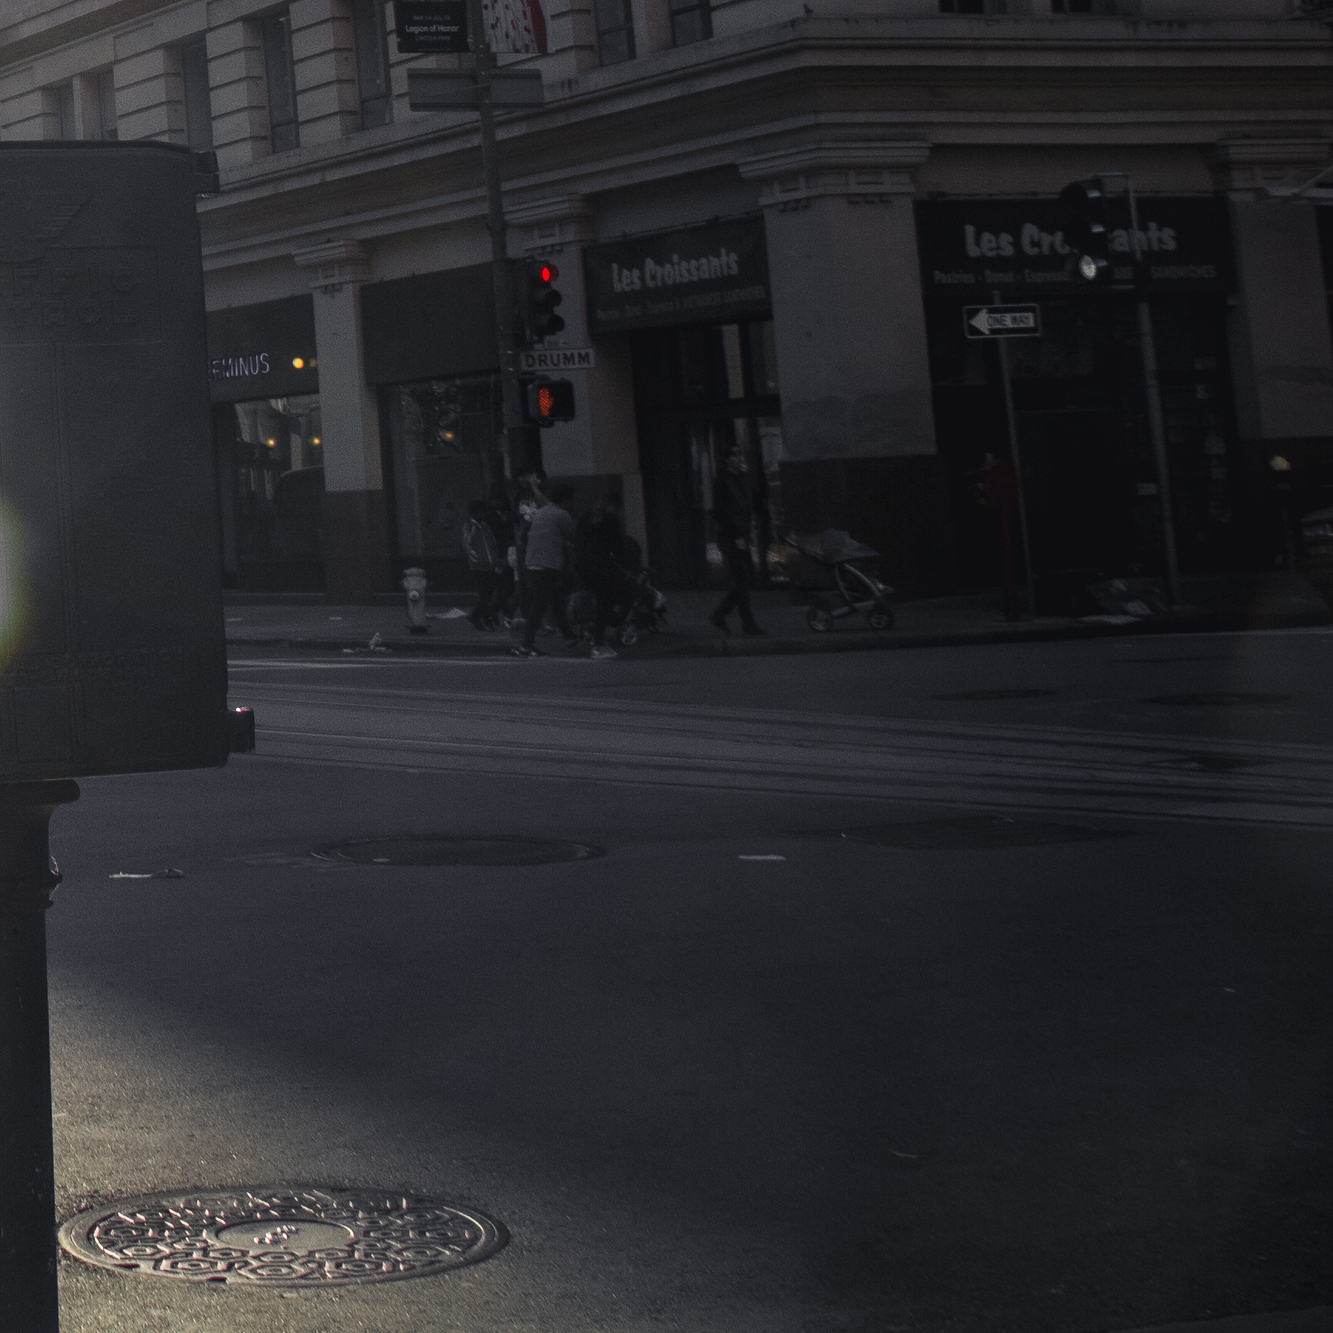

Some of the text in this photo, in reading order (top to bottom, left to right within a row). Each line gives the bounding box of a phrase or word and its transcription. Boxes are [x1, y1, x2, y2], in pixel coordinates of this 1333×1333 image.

[405, 25, 428, 34] Legion
[963, 223, 1014, 257] Les
[611, 247, 739, 293] Les Croissants
[986, 314, 1030, 327] ONE WAY
[210, 352, 270, 379] RMINUS
[525, 351, 591, 368] DRUMM
